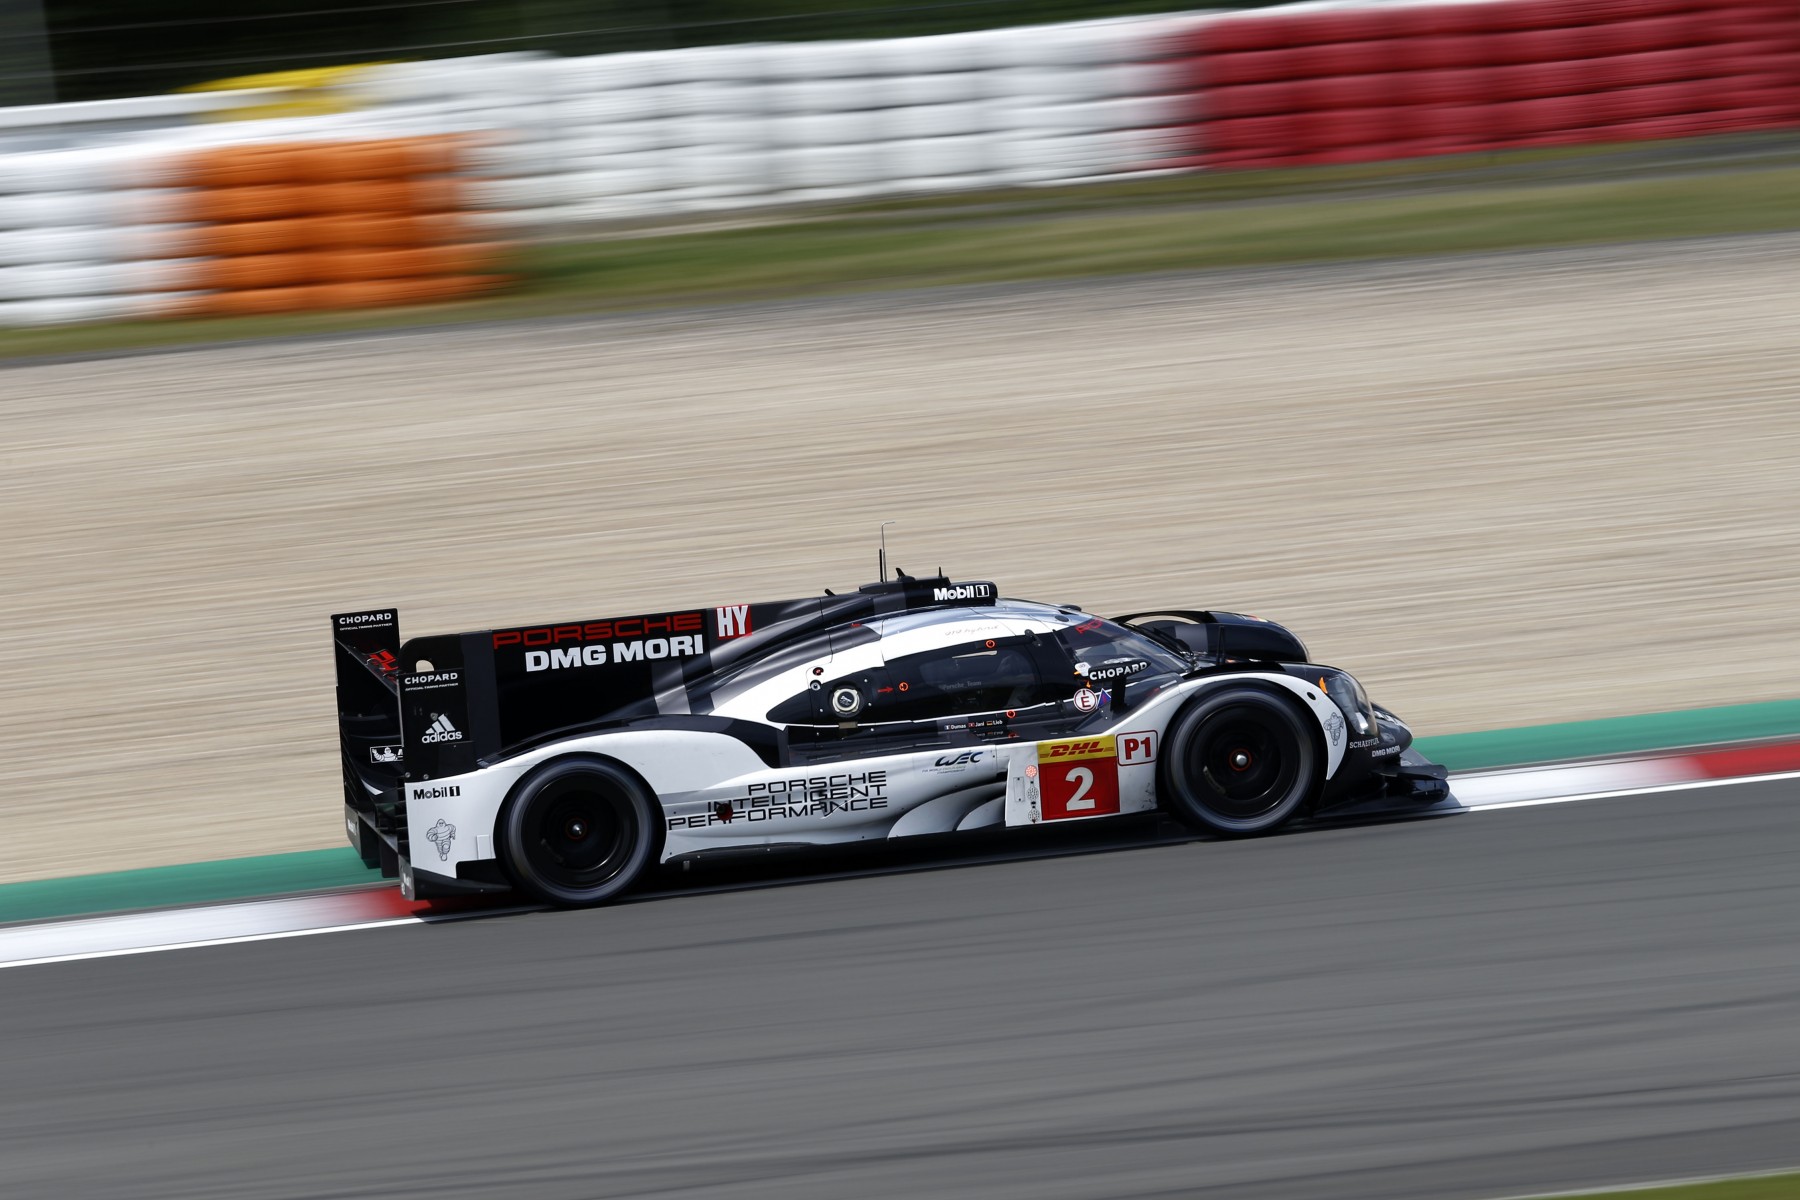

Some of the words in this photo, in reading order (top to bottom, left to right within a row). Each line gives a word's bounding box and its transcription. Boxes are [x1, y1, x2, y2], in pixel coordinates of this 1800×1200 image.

[933, 585, 975, 601] Mobil
[977, 585, 988, 597] 1
[339, 612, 392, 625] CHOPARD
[716, 605, 749, 638] HY
[492, 613, 703, 649] PORSCHE
[525, 645, 607, 672] DMG
[613, 634, 704, 663] MORI
[404, 672, 458, 685] CHOPARD
[1089, 661, 1148, 680] CHOPARD
[1081, 696, 1091, 708] E
[421, 730, 463, 744] adidas
[1050, 741, 1103, 758] DHL
[1124, 737, 1152, 760] P1
[1371, 749, 1386, 758] DMG
[934, 751, 984, 767] WEC
[748, 770, 887, 796] PORSCHE
[1065, 766, 1096, 811] 2
[413, 786, 448, 800] Mobil
[450, 786, 460, 797] 1
